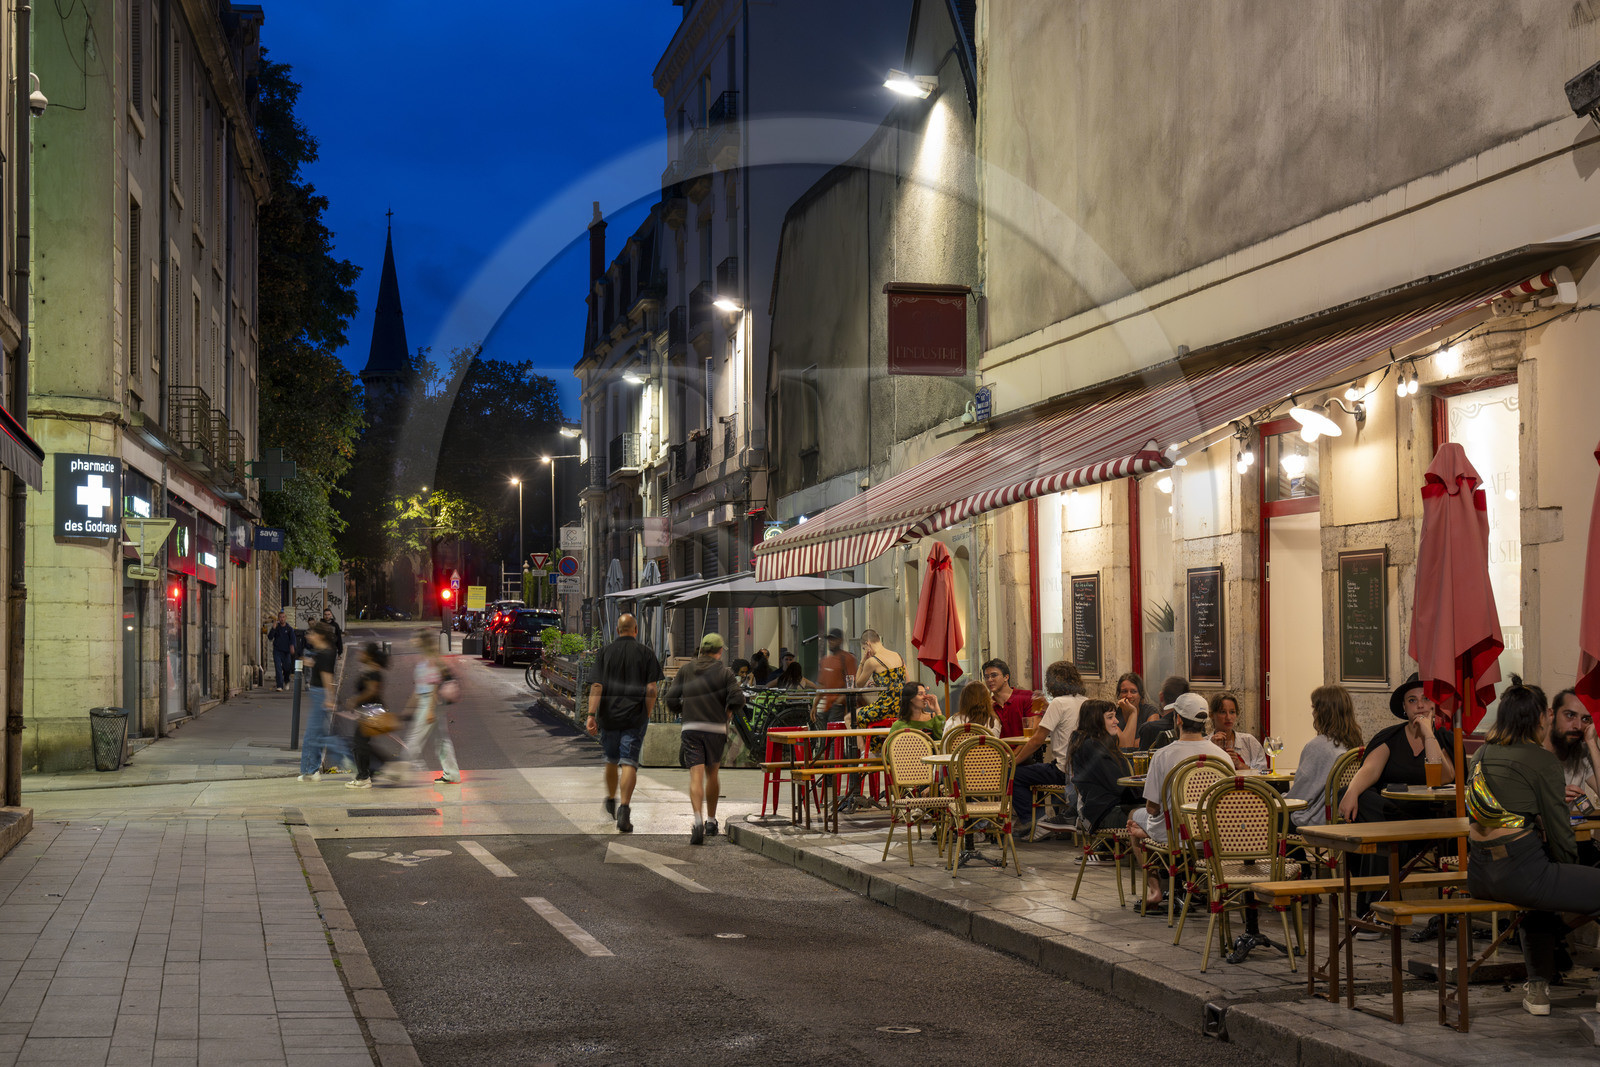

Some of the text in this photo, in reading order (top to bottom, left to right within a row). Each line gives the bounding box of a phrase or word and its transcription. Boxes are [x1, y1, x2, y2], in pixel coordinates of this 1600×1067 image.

[896, 345, 959, 360] L'INDUSTRIE
[70, 458, 115, 473] pharmacie
[64, 519, 117, 533] des Godrans
